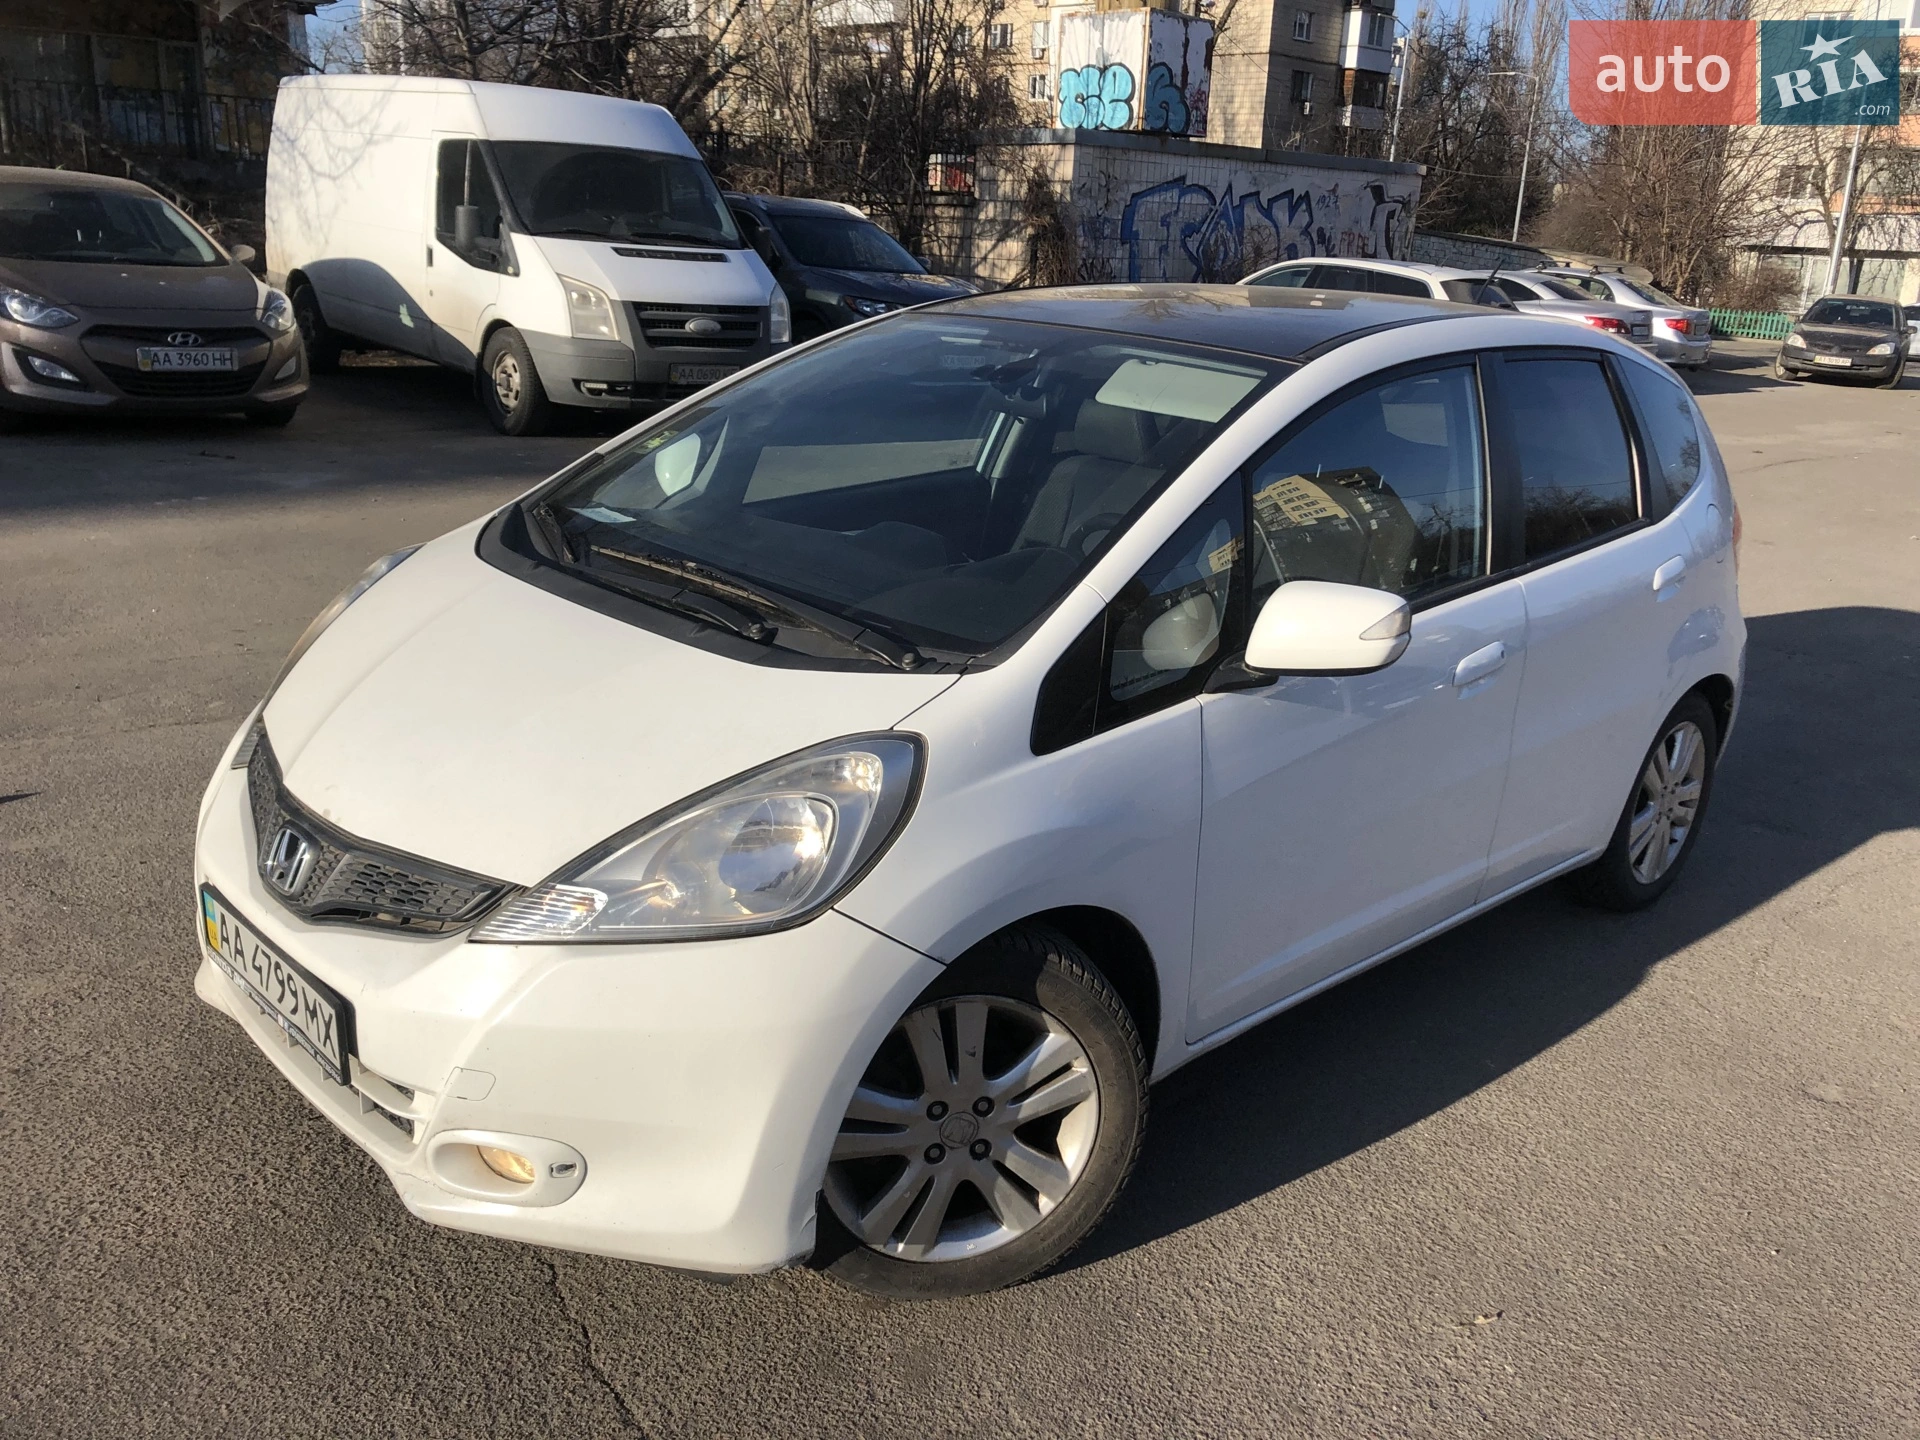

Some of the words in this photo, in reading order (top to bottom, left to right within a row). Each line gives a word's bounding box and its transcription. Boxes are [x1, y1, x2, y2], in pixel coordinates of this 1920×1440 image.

[152, 352, 172, 367] AA
[176, 352, 209, 367] 3960
[212, 352, 233, 368] HH
[679, 368, 694, 379] AA
[220, 911, 247, 972] AA
[251, 943, 299, 1016] 4799
[301, 985, 337, 1060] MX
